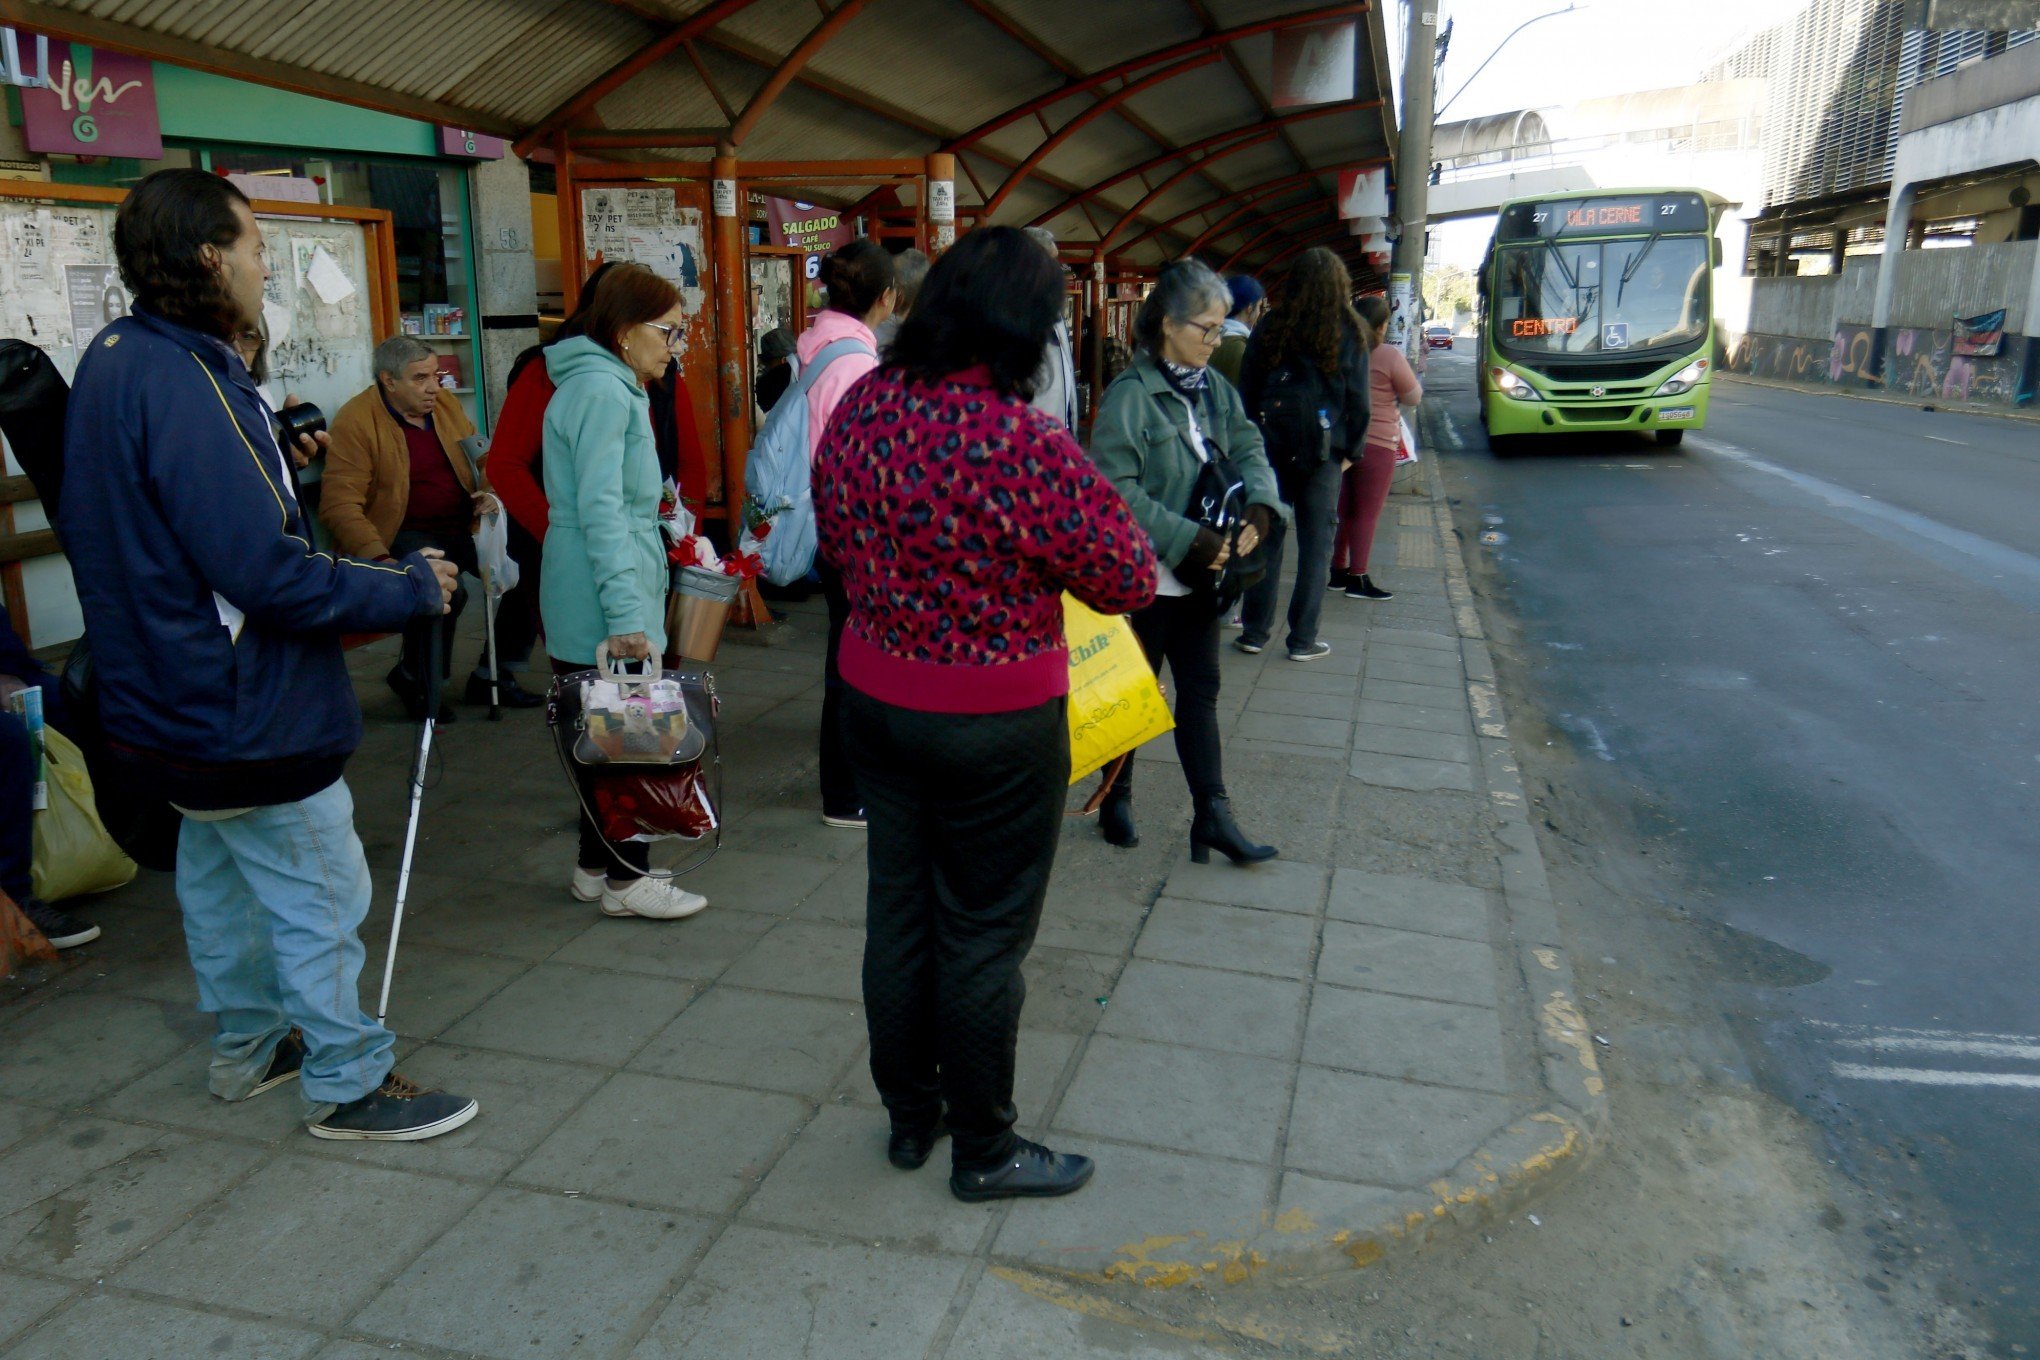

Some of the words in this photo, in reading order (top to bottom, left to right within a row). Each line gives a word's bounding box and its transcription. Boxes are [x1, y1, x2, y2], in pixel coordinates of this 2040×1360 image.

[48, 60, 142, 110] Yes
[1599, 205, 1641, 224] CERNE
[1660, 205, 1677, 215] 27
[607, 214, 623, 223] PET
[1532, 212, 1548, 223] 27
[782, 216, 837, 235] SALGADO
[801, 234, 819, 244] CAFÉ
[813, 242, 831, 252] SUCO
[1513, 317, 1577, 336] CENTRO
